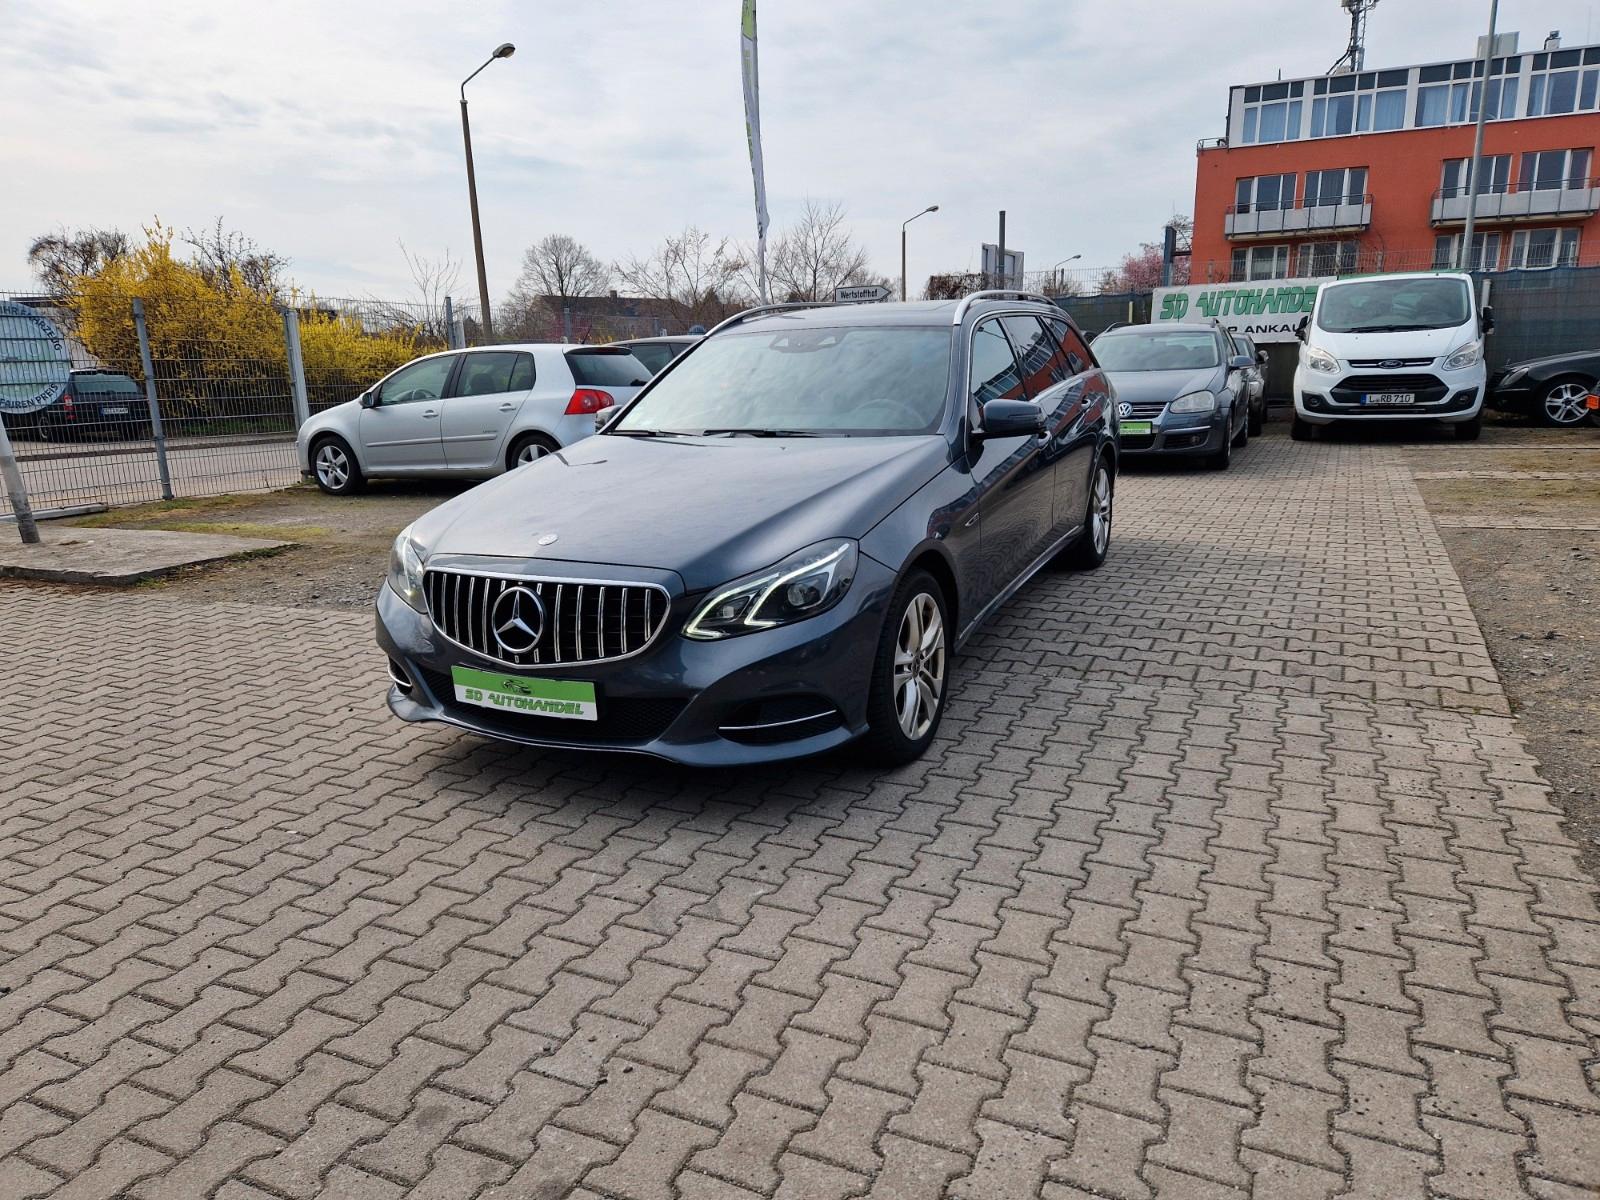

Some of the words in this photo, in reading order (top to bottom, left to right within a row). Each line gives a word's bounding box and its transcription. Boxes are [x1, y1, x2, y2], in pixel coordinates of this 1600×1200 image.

[841, 288, 878, 299] Wertstoffhof
[1160, 292, 1189, 320] SD
[1195, 285, 1319, 317] AUTOHANDE
[35, 383, 59, 404] PREIS
[465, 688, 483, 702] SD
[488, 693, 584, 715] AUTOHANDEL
